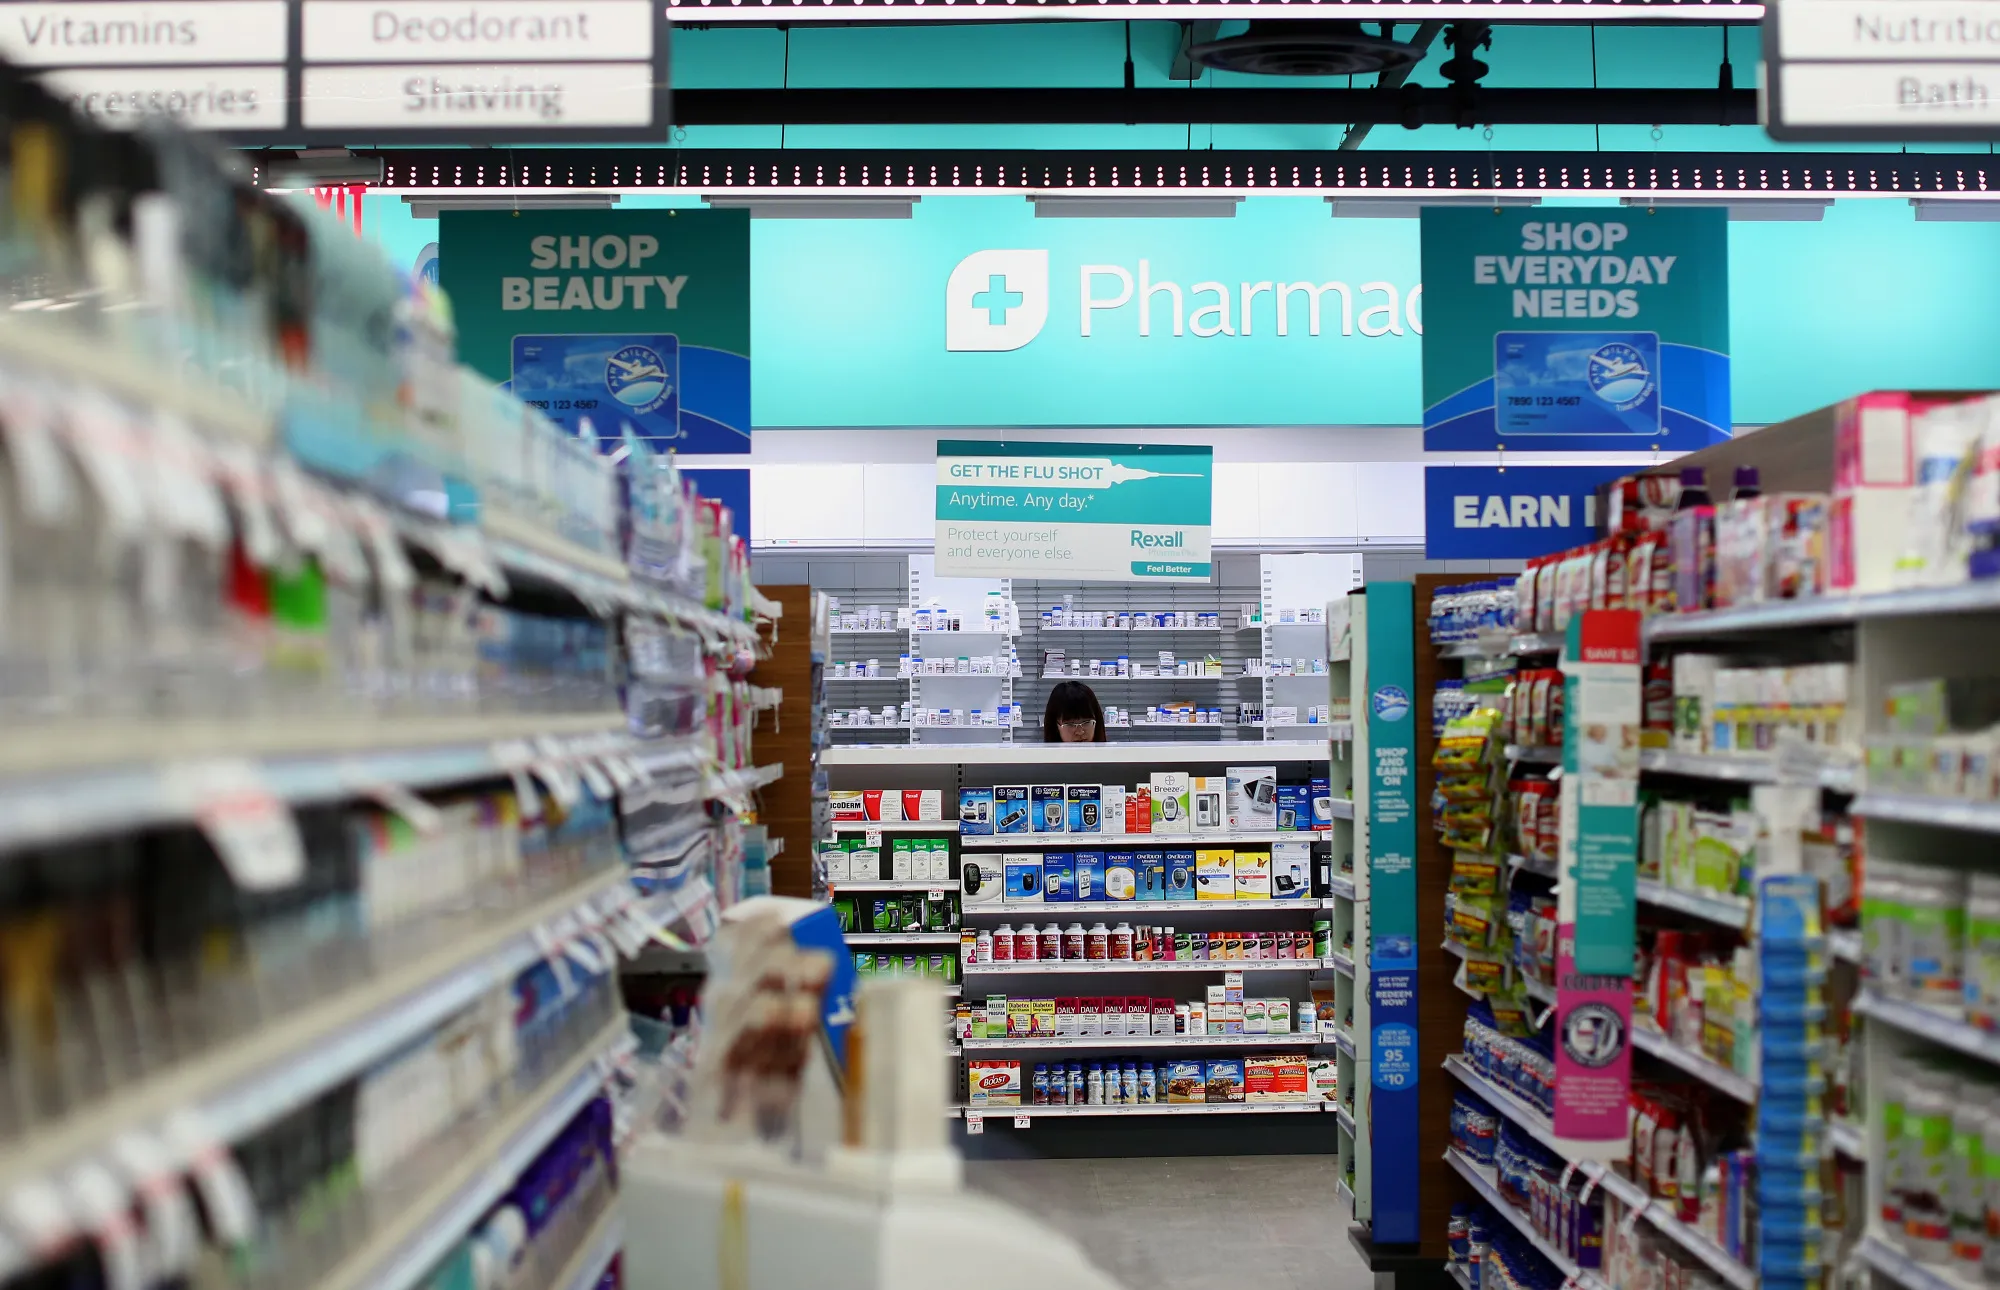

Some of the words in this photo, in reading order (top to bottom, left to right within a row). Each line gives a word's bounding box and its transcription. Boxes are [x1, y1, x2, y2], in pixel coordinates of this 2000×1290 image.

[21, 13, 198, 45] Vitamins
[371, 8, 590, 43] Deodorant
[68, 80, 260, 116] ccessories
[402, 77, 565, 119] Shaving
[1897, 75, 1989, 111] Bath
[1521, 222, 1629, 251] SHOP
[530, 235, 659, 270] SHOP
[1474, 255, 1678, 284] EVERYDAY
[502, 275, 689, 311] BEAUTY
[1512, 288, 1640, 319] NEEDS
[619, 348, 658, 364] MILES
[1601, 346, 1638, 361] MILES
[553, 400, 570, 410] 123
[573, 400, 598, 410] 4567
[1507, 396, 1533, 406] 7890
[1536, 396, 1554, 406] 123
[1556, 396, 1581, 406] 4567
[950, 464, 983, 477] GET
[987, 465, 1019, 478] THE
[1024, 466, 1053, 480] FLU
[1059, 466, 1103, 480] SHOT
[949, 491, 1018, 509] Anytime.
[1023, 493, 1053, 510] Any
[1454, 496, 1570, 528] EARN
[948, 528, 998, 541] Protect
[1003, 529, 1058, 544] yourself
[1131, 529, 1183, 548] Rexall
[947, 545, 972, 558] and
[977, 547, 1040, 561] everyone
[1044, 547, 1074, 560] else.
[1146, 564, 1164, 573] Feel
[1166, 565, 1192, 573] Better
[1375, 748, 1408, 758] SHOP
[1380, 758, 1404, 767] AND
[1375, 766, 1407, 776] EARN
[1383, 775, 1401, 786] ON
[1375, 990, 1413, 999] REDEEM
[1381, 998, 1407, 1007] NOW!
[1384, 1050, 1403, 1062] 95
[983, 1076, 1007, 1088] BOOST
